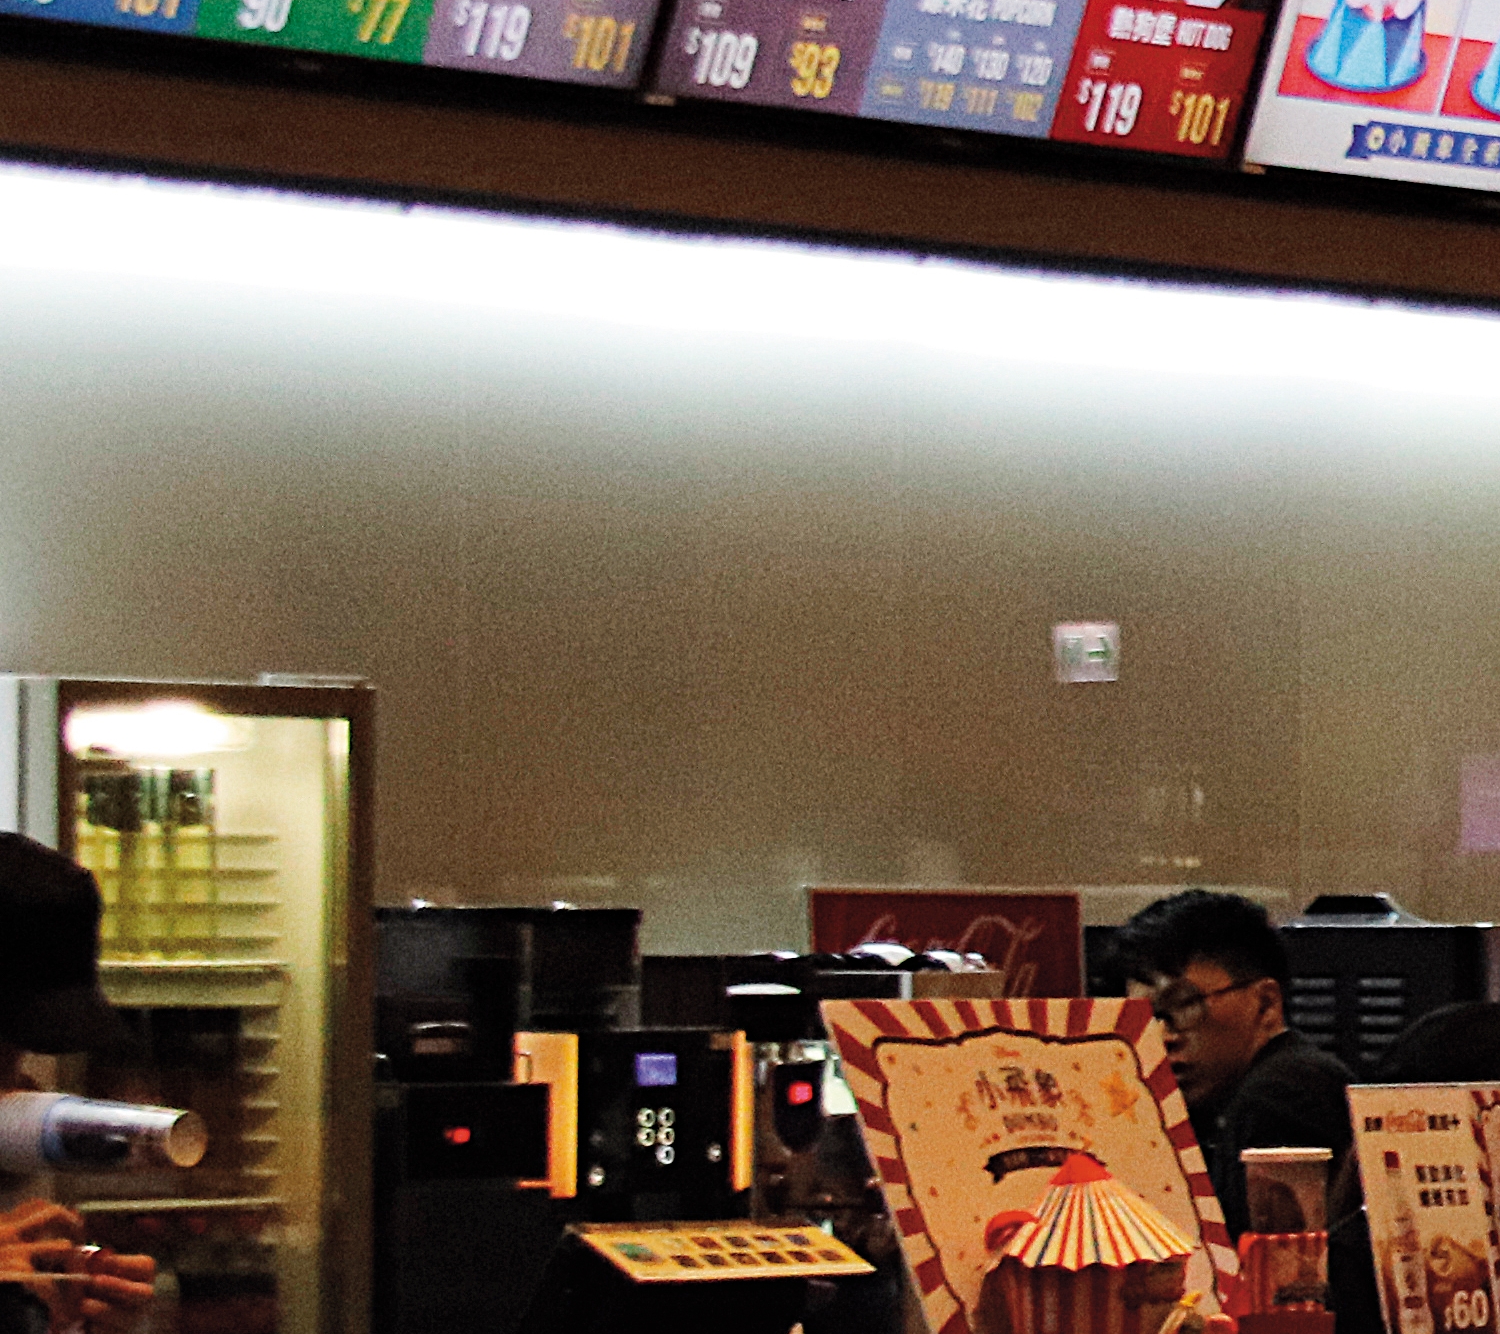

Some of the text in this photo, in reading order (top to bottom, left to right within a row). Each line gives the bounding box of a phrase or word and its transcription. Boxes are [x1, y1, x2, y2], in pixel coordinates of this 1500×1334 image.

[564, 14, 635, 73] $101
[1109, 6, 1177, 48] 熱狗堡
[685, 28, 842, 99] $109 $93
[1075, 76, 1231, 146] $119 $101
